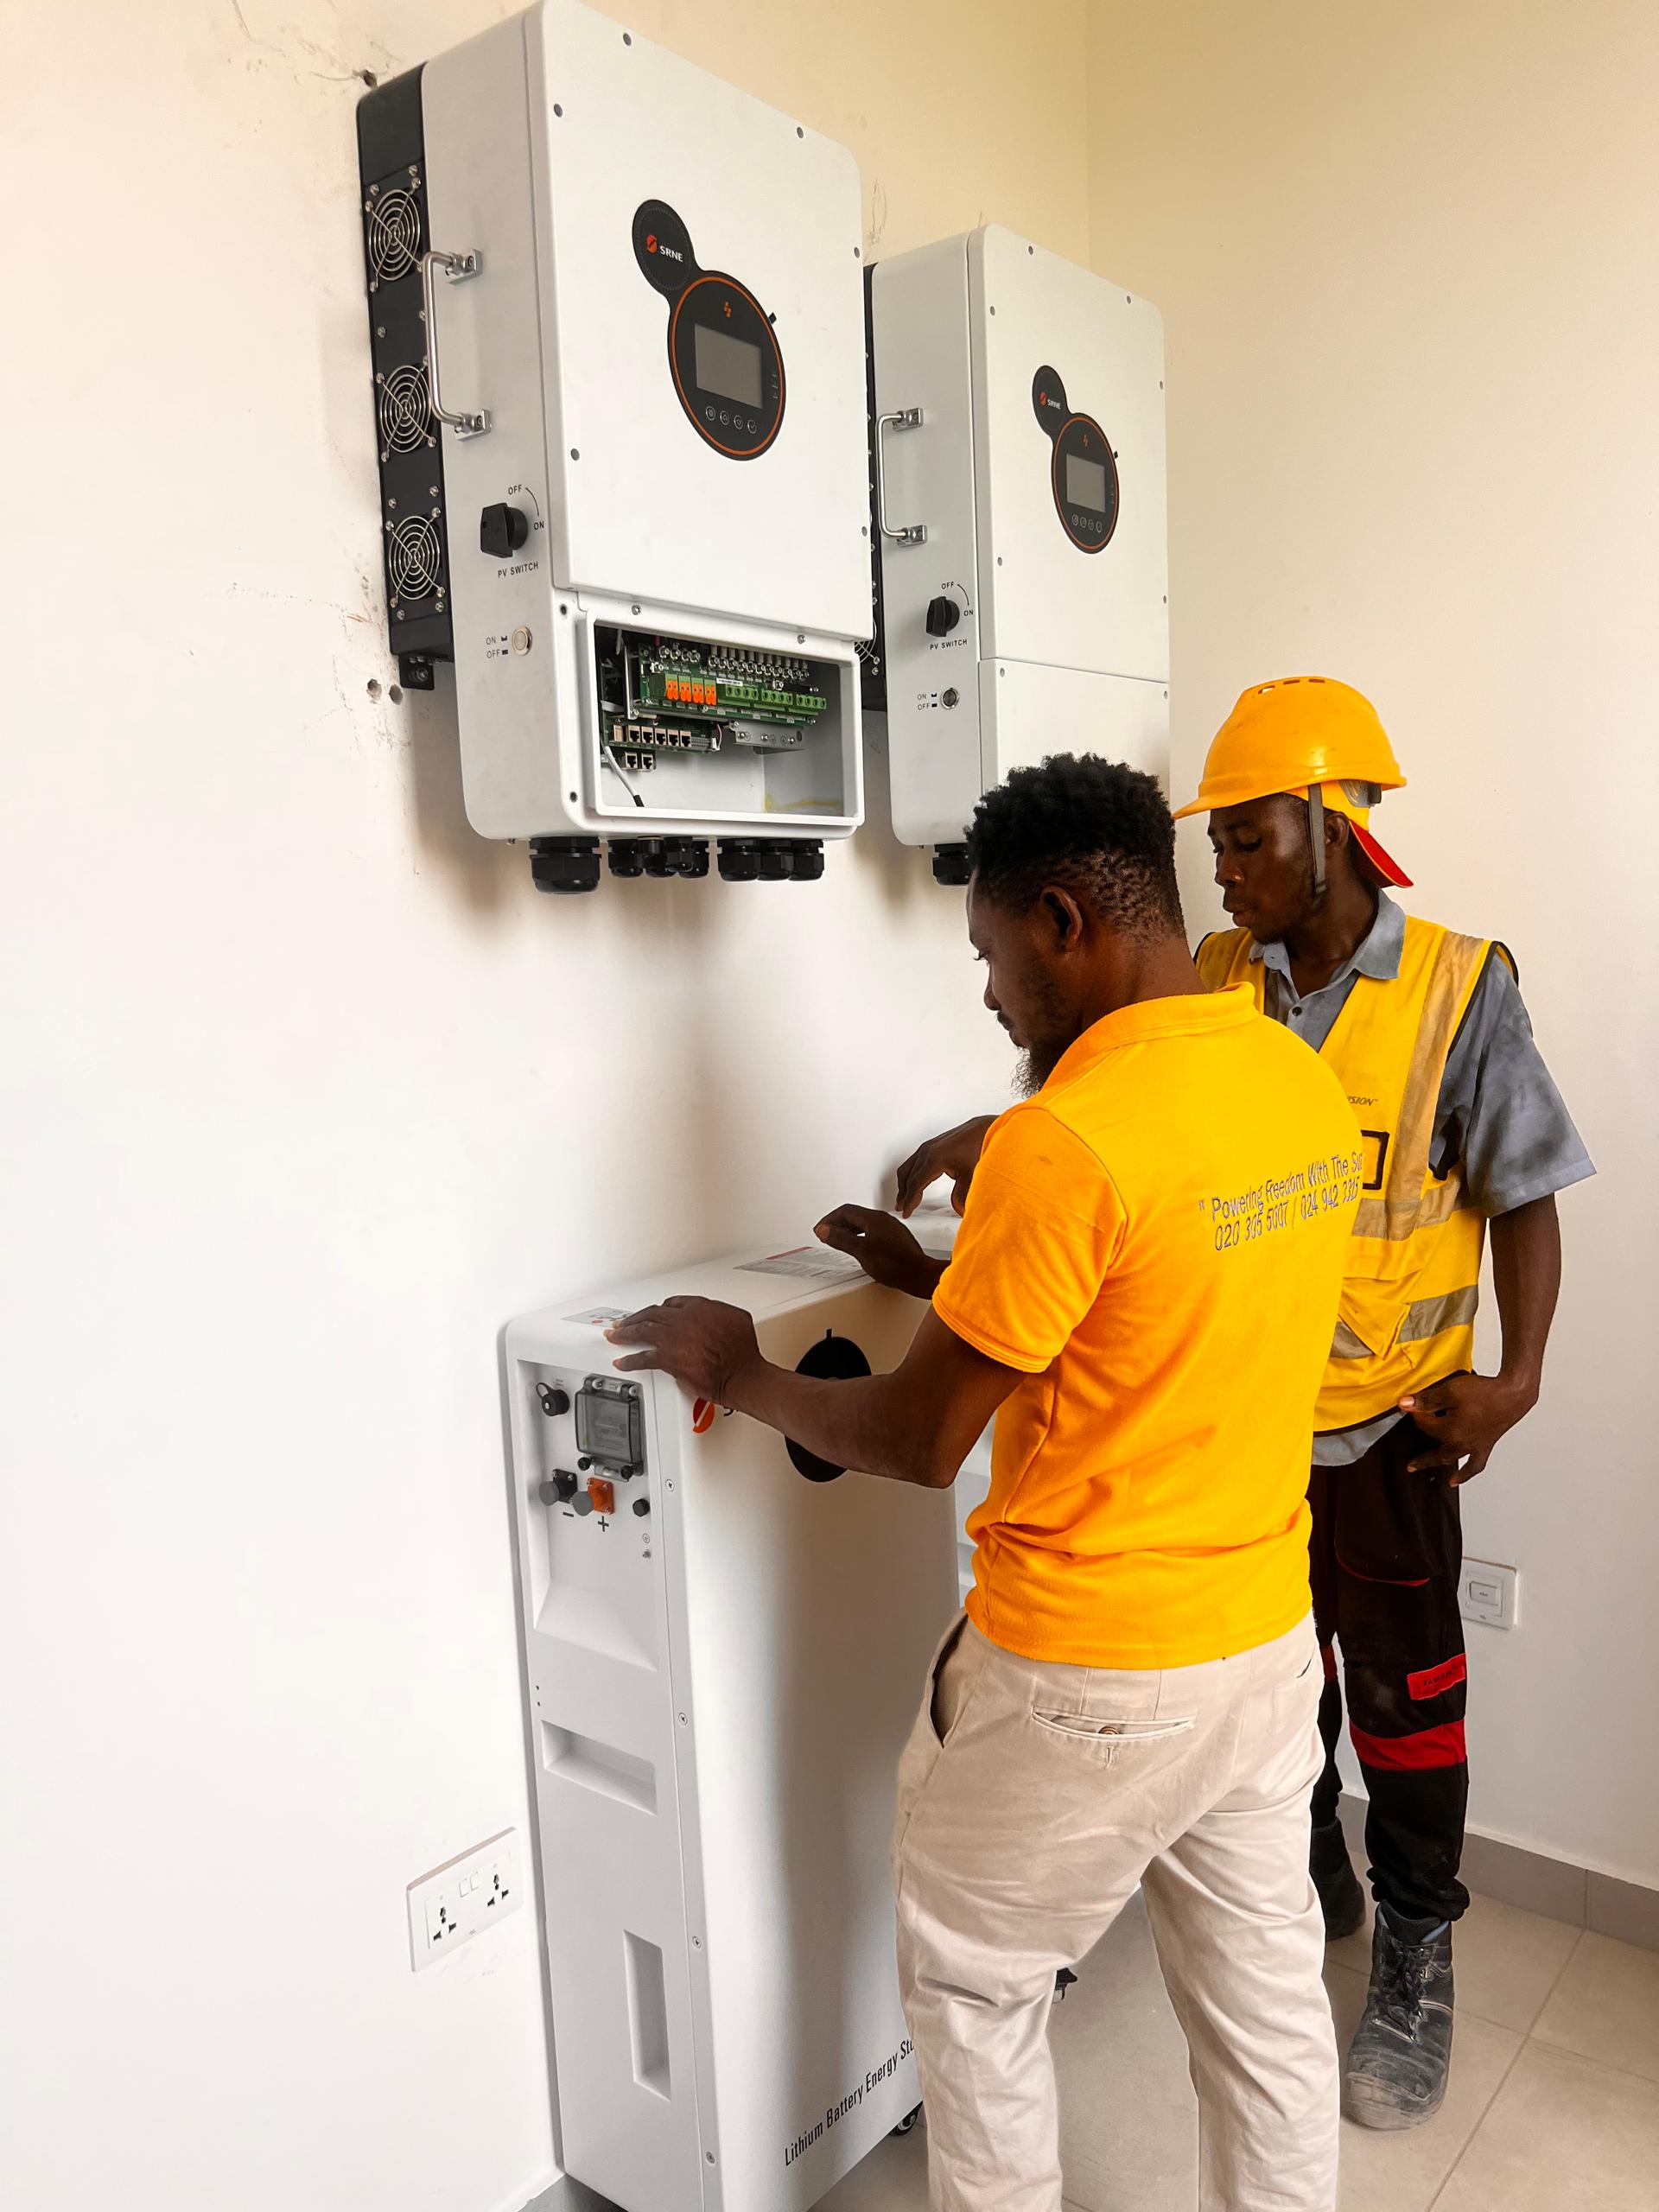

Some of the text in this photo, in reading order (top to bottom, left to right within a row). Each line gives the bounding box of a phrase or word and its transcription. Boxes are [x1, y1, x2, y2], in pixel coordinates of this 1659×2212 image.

[659, 245, 683, 263] SRNE
[508, 484, 523, 495] OFF
[533, 521, 544, 531] ON
[498, 562, 538, 578] PV SWITCH
[941, 582, 955, 590] OFF
[486, 636, 496, 645] ON
[941, 639, 968, 650] SWITCH
[486, 650, 500, 659] OFF
[918, 702, 931, 711] OFF
[1211, 1185, 1263, 1222] Powering
[1265, 1171, 1306, 1203] Freedom
[1307, 1160, 1330, 1188] With
[1332, 1154, 1348, 1179] The
[1215, 1220, 1240, 1251] 020
[1300, 1189, 1319, 1220] 024
[1321, 1184, 1338, 1212] 942
[785, 2122, 823, 2167] Lithium
[826, 2084, 864, 2129] Battery
[866, 2052, 898, 2094] Energy
